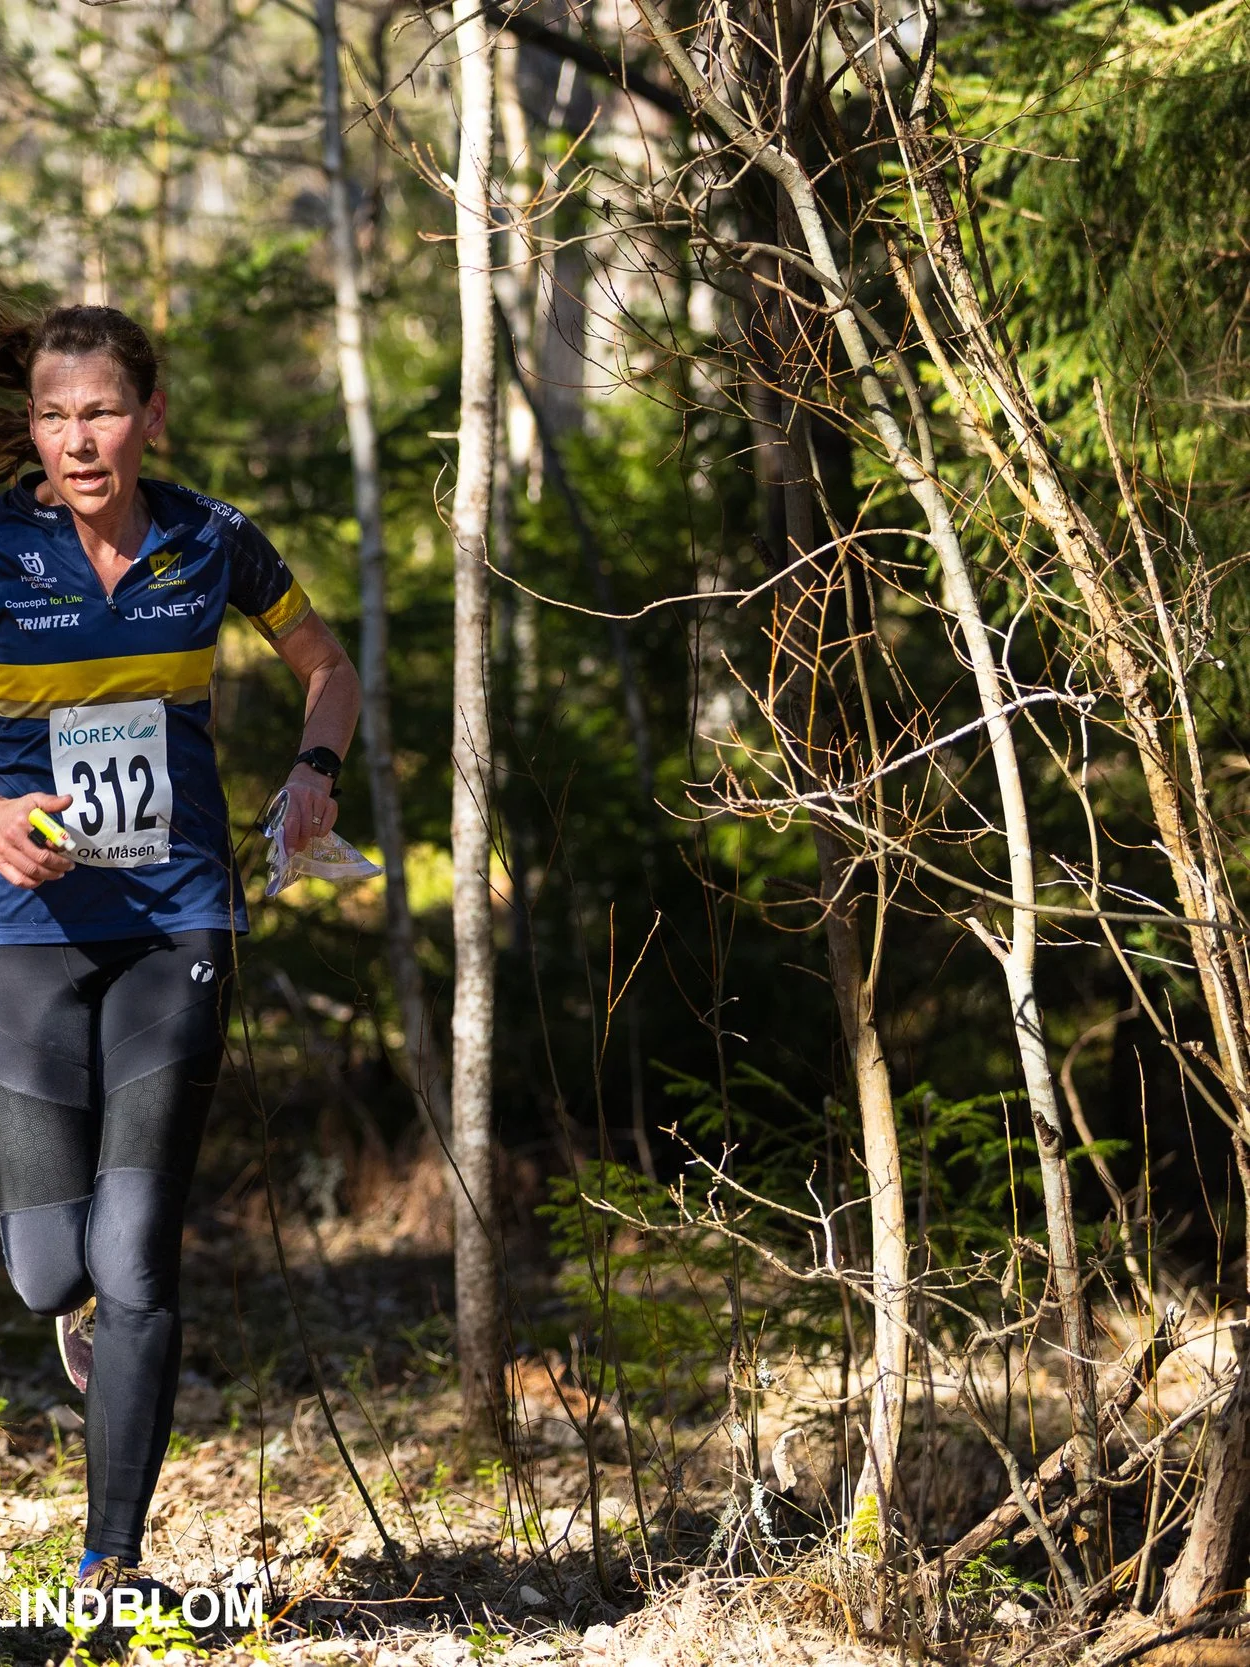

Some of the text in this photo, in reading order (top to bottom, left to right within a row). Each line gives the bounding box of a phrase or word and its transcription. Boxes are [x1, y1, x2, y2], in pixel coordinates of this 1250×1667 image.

[195, 496, 230, 517] GROUP
[5, 598, 47, 609] Concept
[49, 596, 63, 605] for
[125, 602, 198, 620] JUNET
[15, 613, 80, 630] TRIMTEX
[58, 725, 125, 747] NOREX
[72, 754, 157, 837] 312
[77, 844, 155, 860] OK Måsen
